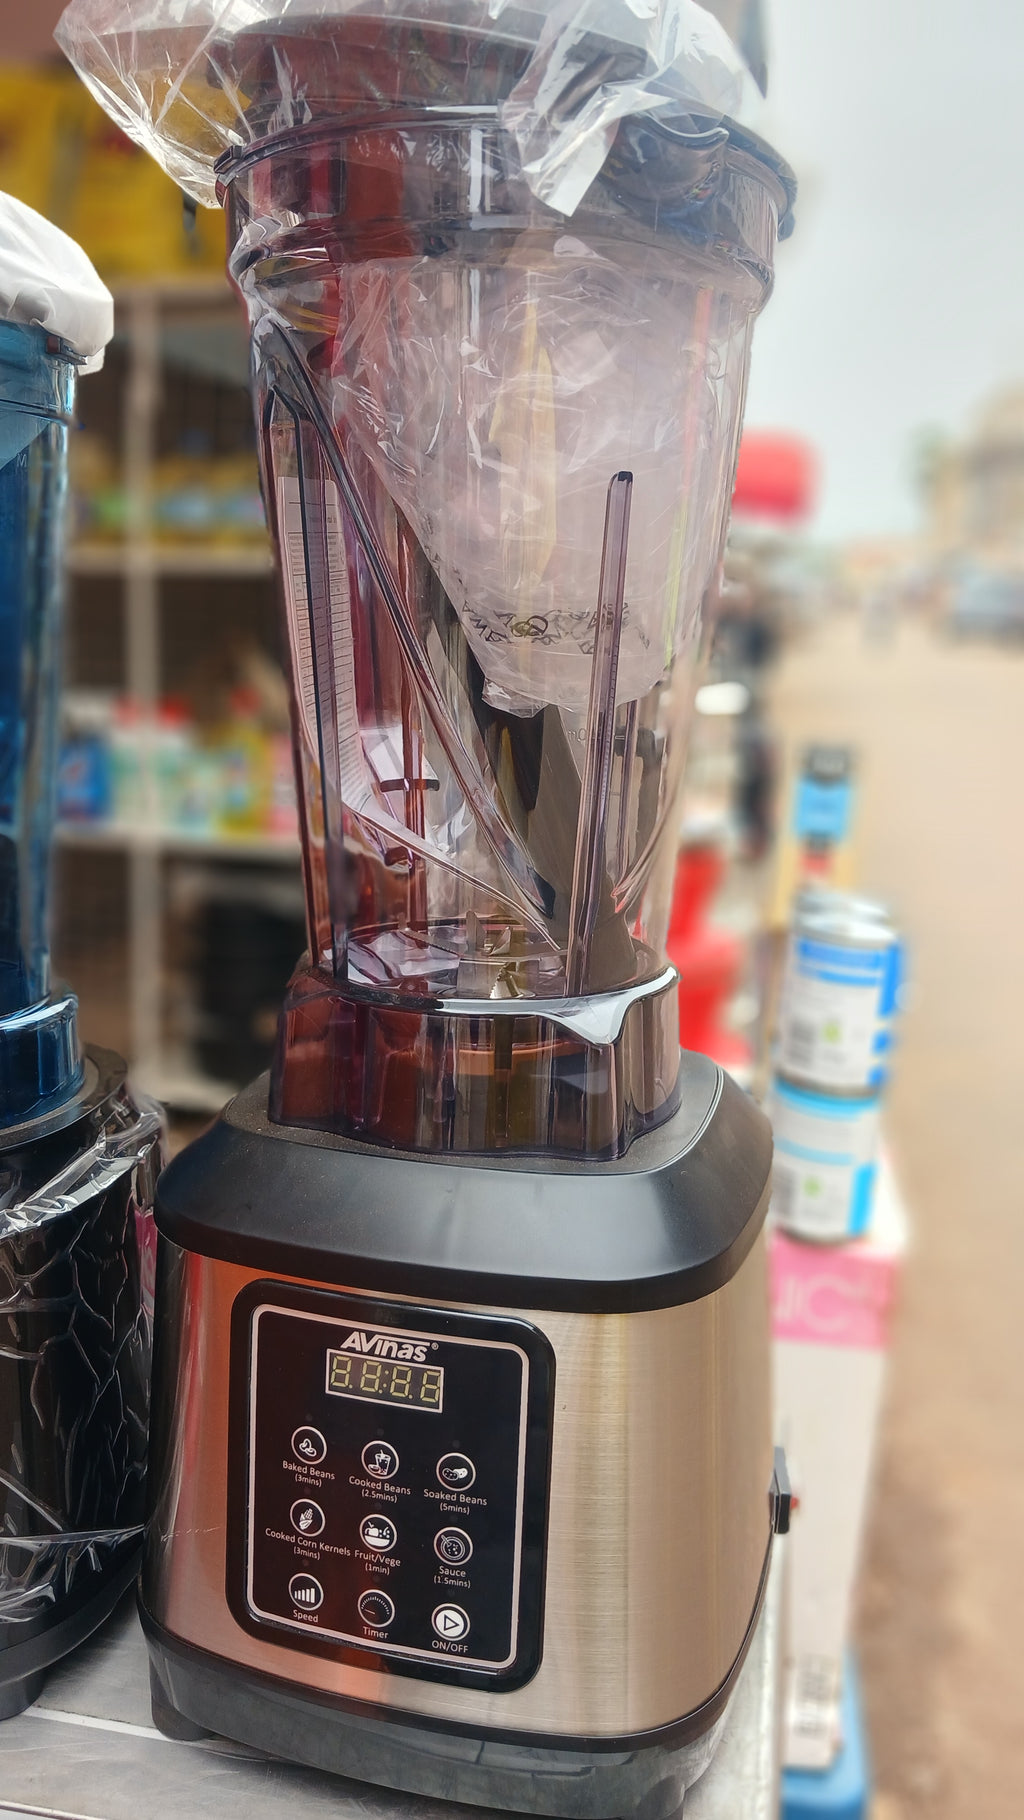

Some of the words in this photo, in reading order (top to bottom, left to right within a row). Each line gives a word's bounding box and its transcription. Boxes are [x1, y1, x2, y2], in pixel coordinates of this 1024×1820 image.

[282, 1460, 308, 1474] Baked
[310, 1467, 336, 1480] Beans
[294, 1473, 322, 1488] (3mins)
[349, 1475, 382, 1489] Cooked
[384, 1482, 411, 1495] Beans
[361, 1489, 398, 1503] (2.5mins)
[423, 1488, 457, 1501] Soaked
[459, 1493, 488, 1506] Beans
[440, 1502, 470, 1515] (5mins)
[265, 1528, 296, 1543] Cooked
[297, 1536, 317, 1549] Corn
[319, 1542, 351, 1556] Kernels
[293, 1546, 320, 1560] (3mins)
[354, 1550, 401, 1567] Fruit/Vege
[365, 1563, 390, 1575] (1min)
[439, 1565, 466, 1578] Sauce
[433, 1575, 471, 1589] (1.5mins)
[292, 1609, 319, 1623] Speed
[362, 1626, 389, 1640] Timer
[431, 1640, 469, 1654] ON/OFF
